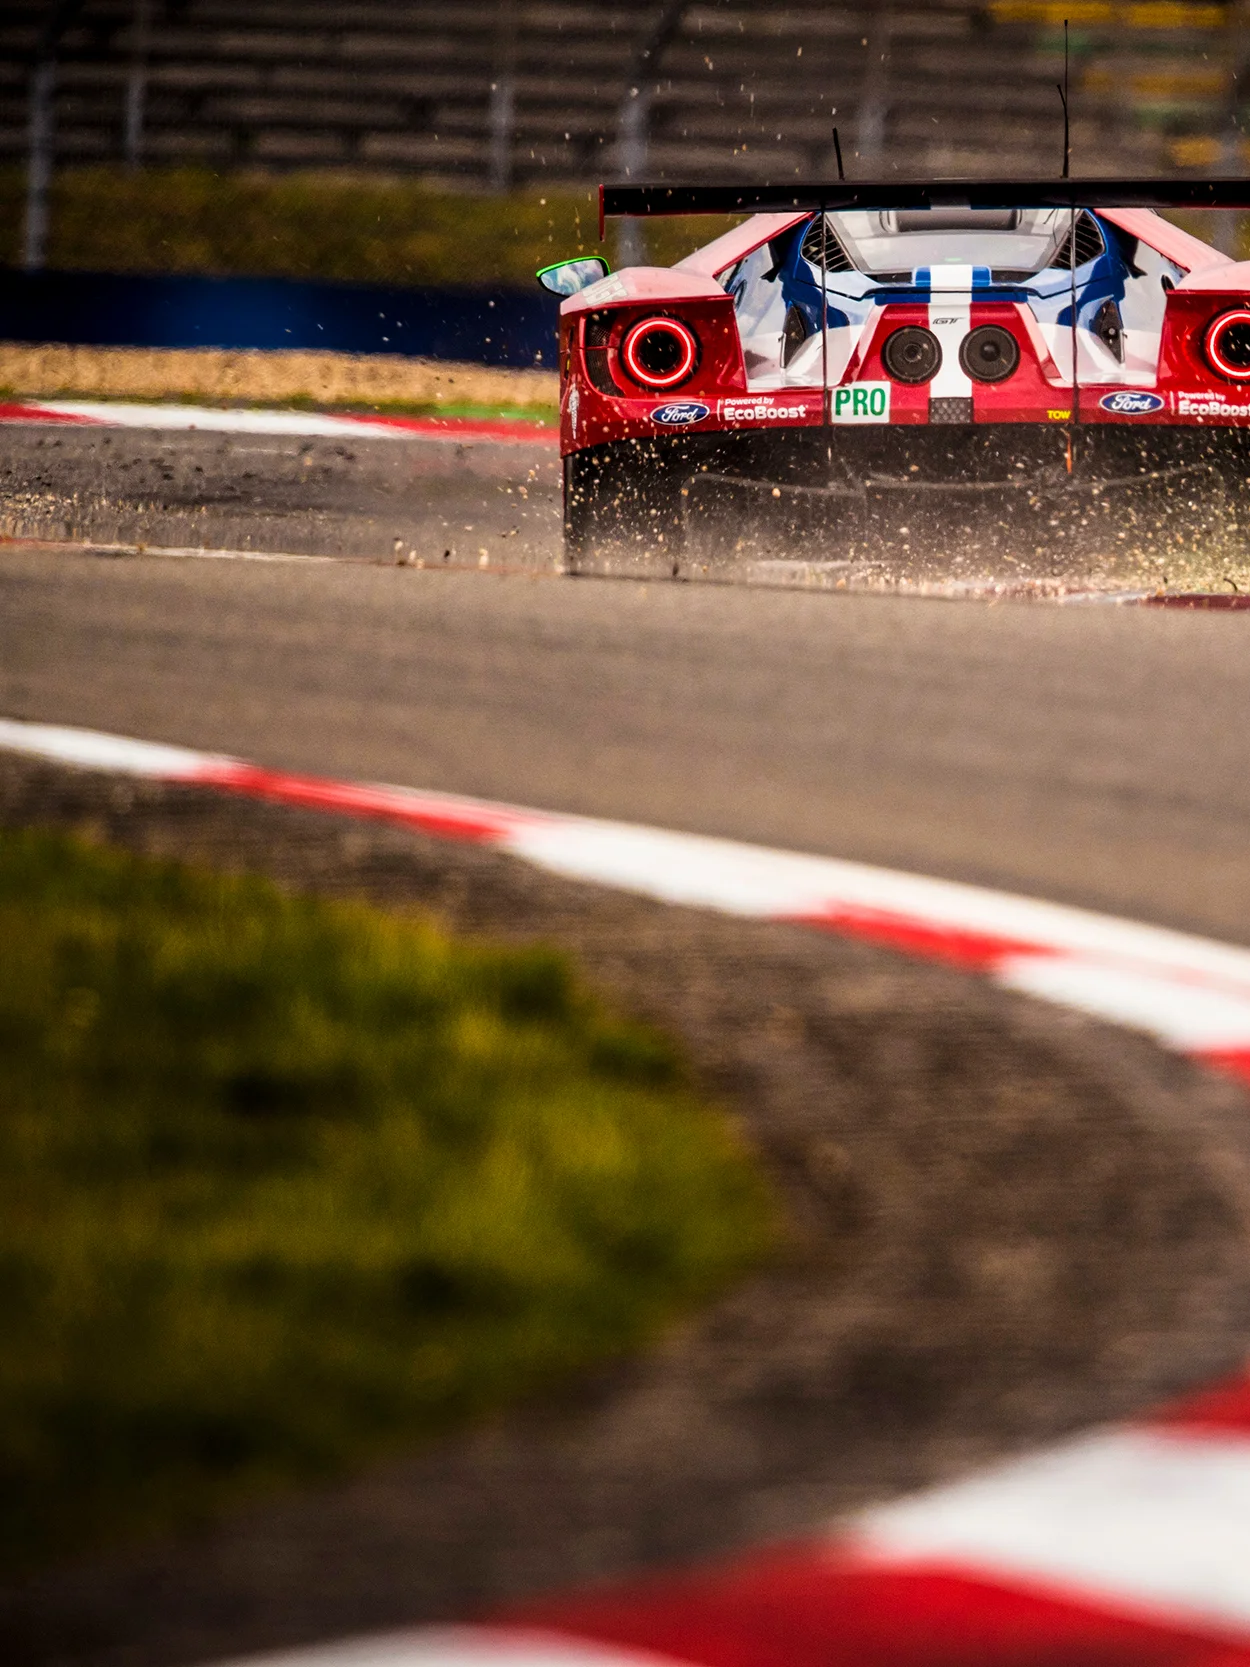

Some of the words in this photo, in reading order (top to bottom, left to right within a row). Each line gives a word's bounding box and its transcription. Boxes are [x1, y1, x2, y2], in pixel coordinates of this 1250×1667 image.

[724, 397, 761, 406] Powered
[763, 397, 774, 405] by
[835, 388, 886, 416] PRO
[1111, 394, 1151, 411] Ford
[1178, 391, 1214, 400] Powered
[1215, 394, 1226, 402] by
[661, 405, 699, 422] Ford
[724, 405, 806, 420] EcoBoost
[1047, 410, 1071, 420] TOW
